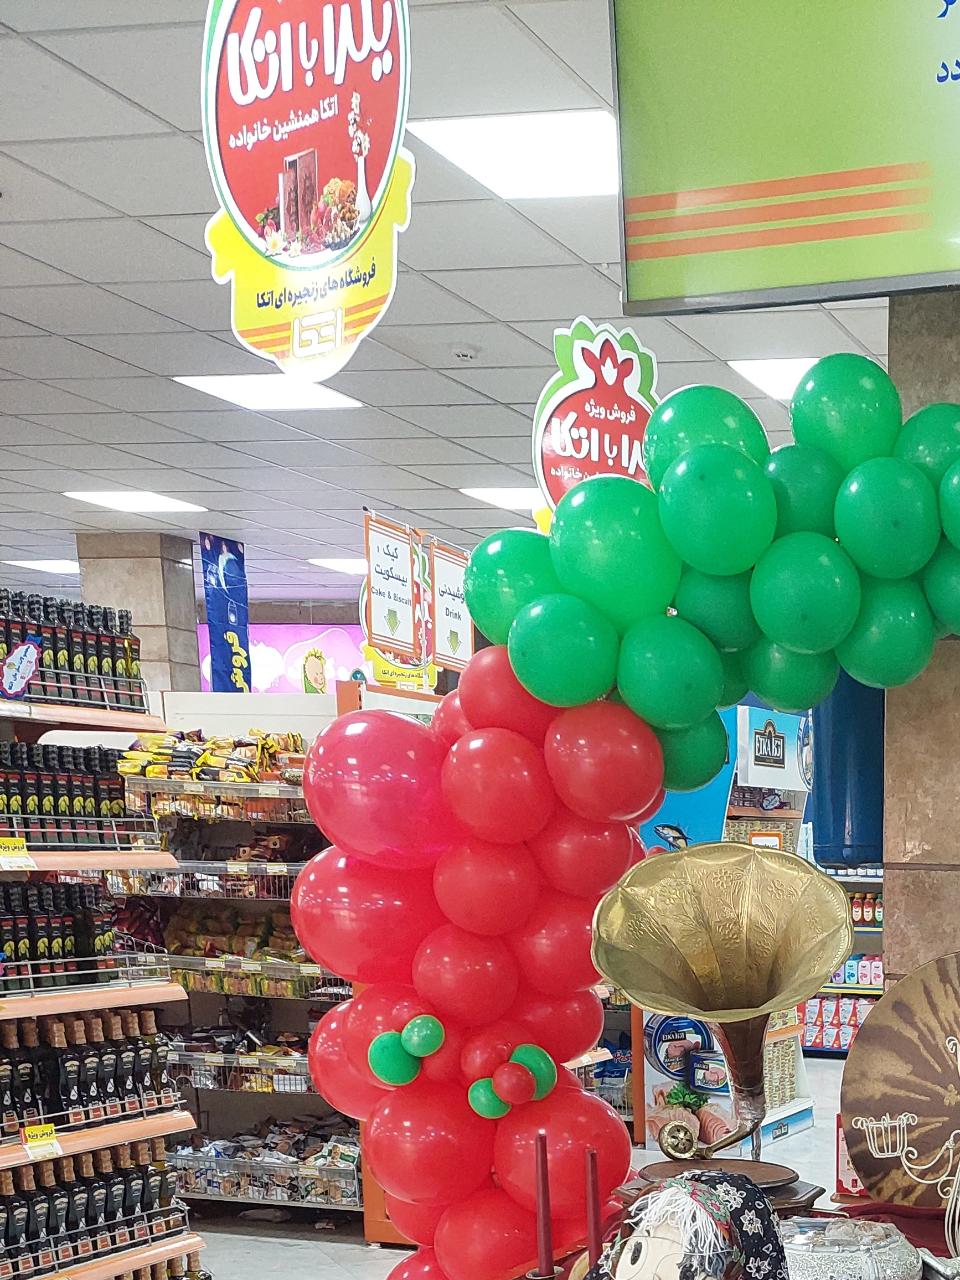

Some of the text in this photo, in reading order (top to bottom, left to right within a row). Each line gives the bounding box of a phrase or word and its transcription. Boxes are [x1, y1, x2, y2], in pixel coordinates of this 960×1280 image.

[227, 7, 293, 106] اتکا
[299, 21, 319, 87] با
[228, 93, 339, 151] اتکا همنشین خانواده
[256, 256, 377, 309] فروشگاه های زنجیره ای اتکا
[551, 411, 599, 462] اتکا
[584, 398, 636, 424] فروش ویژه
[604, 433, 618, 466] با
[438, 584, 465, 604] وشیدنی
[445, 606, 462, 621] Drink
